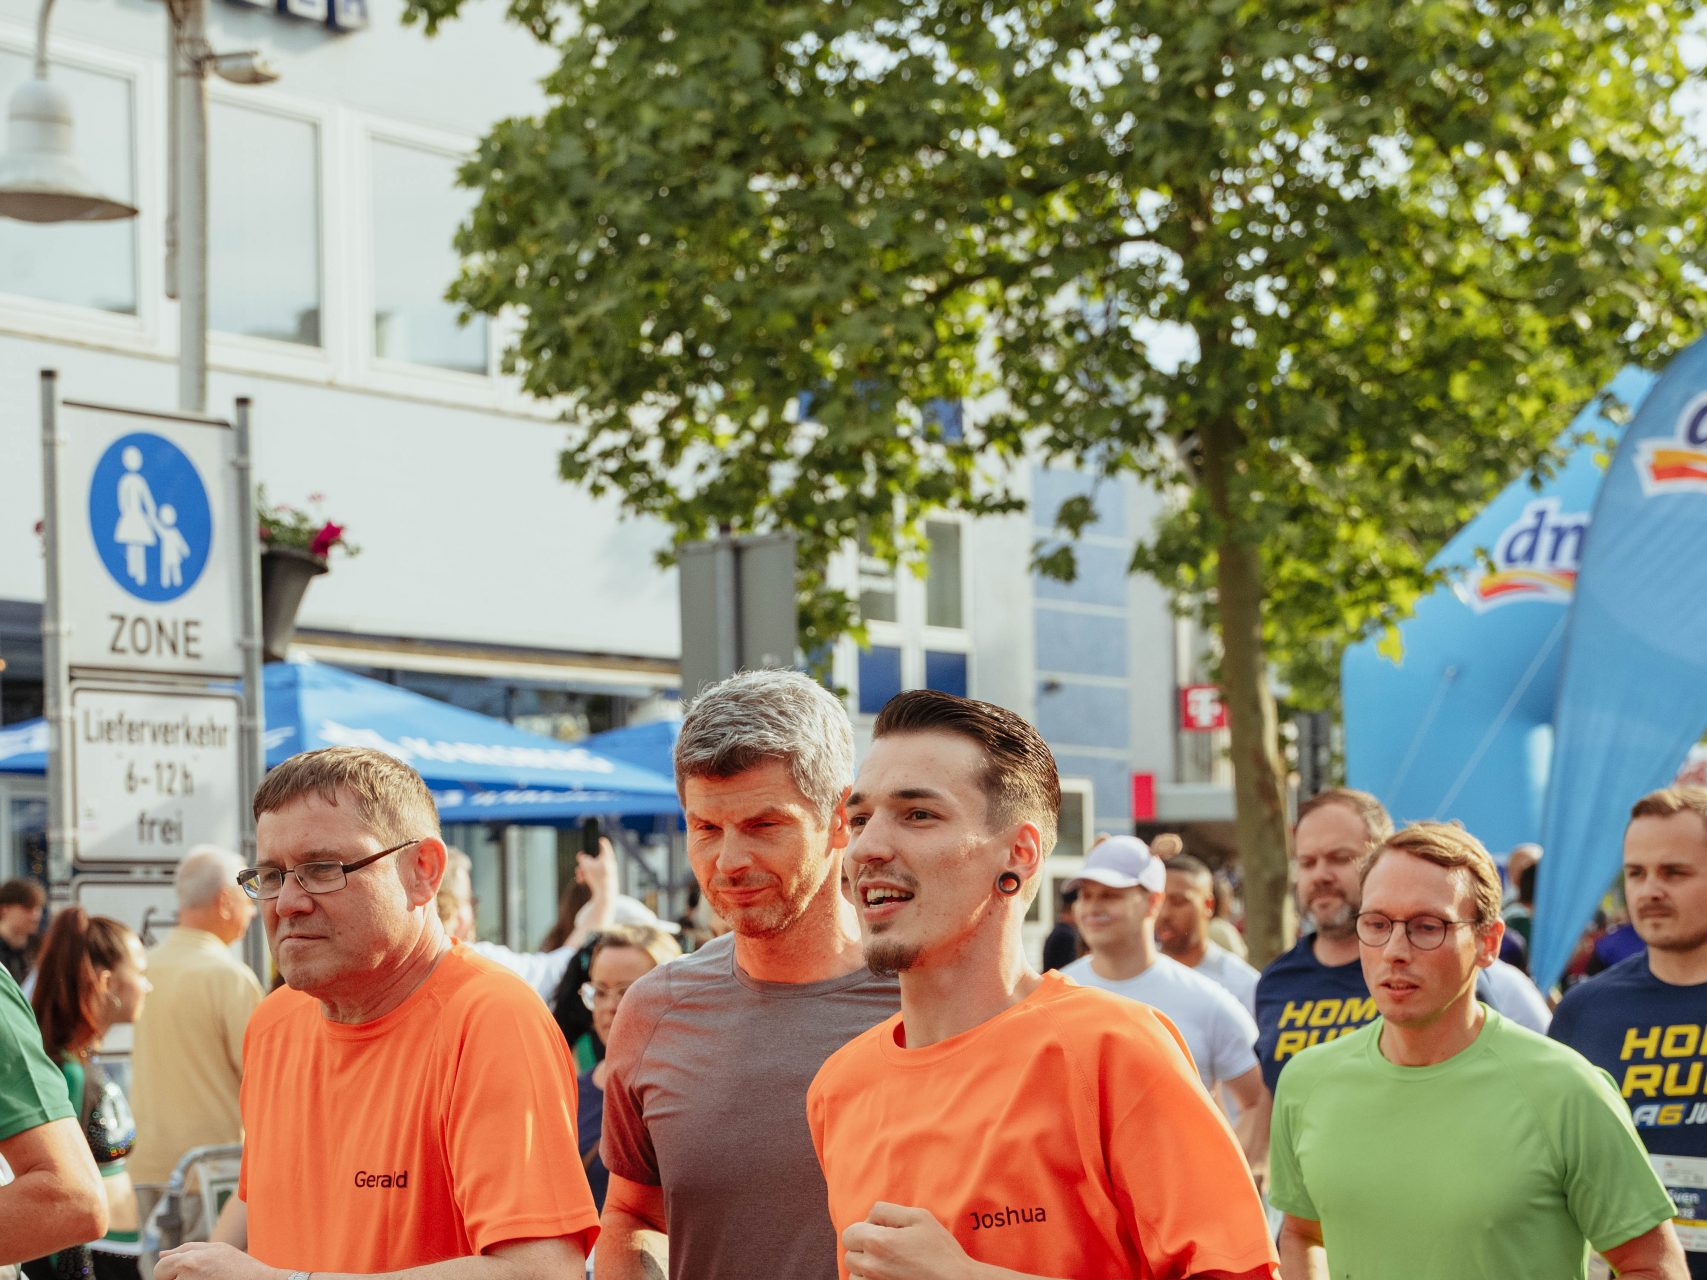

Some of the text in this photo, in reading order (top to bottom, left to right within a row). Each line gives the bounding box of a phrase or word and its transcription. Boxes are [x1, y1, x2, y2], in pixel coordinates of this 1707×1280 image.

[109, 613, 203, 660] ZONE
[84, 709, 230, 749] Lieferverkehr
[137, 809, 184, 845] frei
[1278, 996, 1378, 1029] HOM
[1274, 1026, 1358, 1062] RU
[1619, 1024, 1707, 1061] HO
[1622, 1061, 1707, 1098] RU
[354, 1170, 408, 1188] Gerald
[970, 1206, 1046, 1230] Joshua
